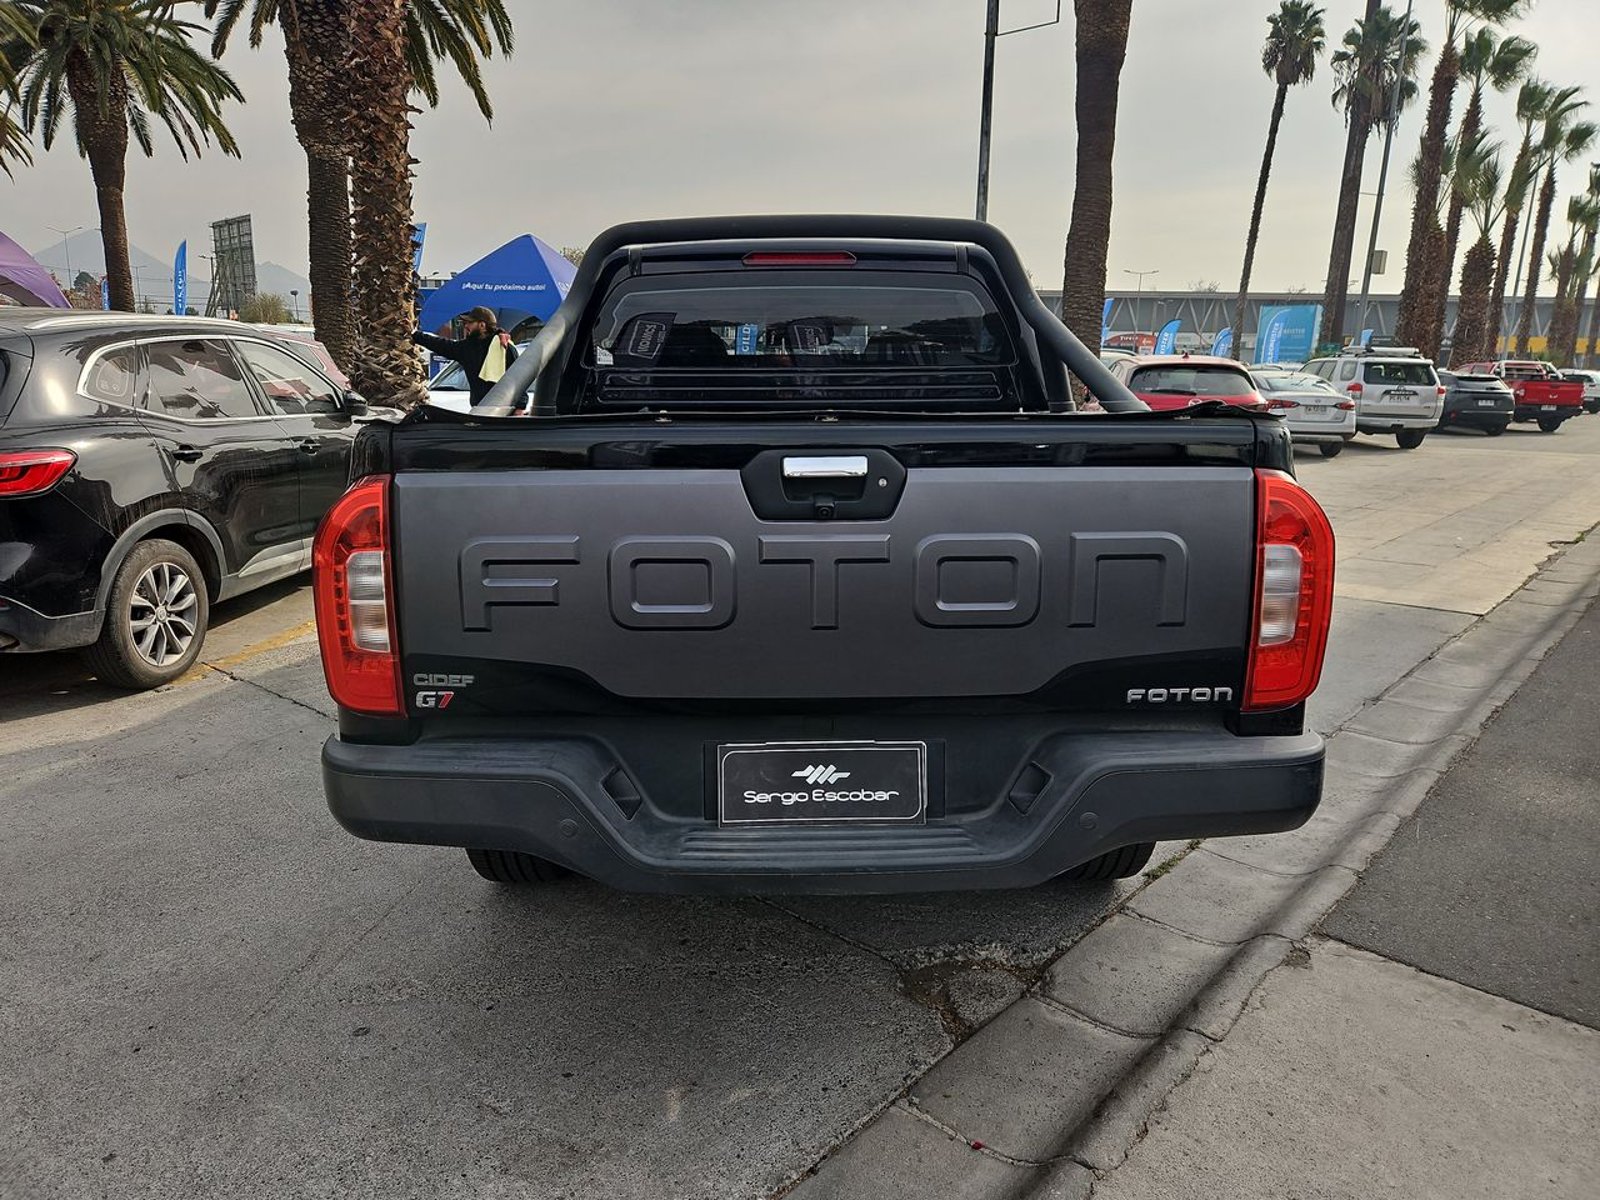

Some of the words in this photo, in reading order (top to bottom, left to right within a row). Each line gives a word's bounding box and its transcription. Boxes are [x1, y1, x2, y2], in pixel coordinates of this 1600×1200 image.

[484, 283, 493, 291] tu
[493, 282, 526, 292] próximo
[742, 323, 751, 352] GILD
[457, 531, 1190, 633] FOTON
[413, 673, 475, 687] CIDEF
[415, 691, 454, 708] G7
[1126, 686, 1234, 703] FOTON
[743, 789, 809, 806] Sergio
[811, 788, 900, 802] Escobar
